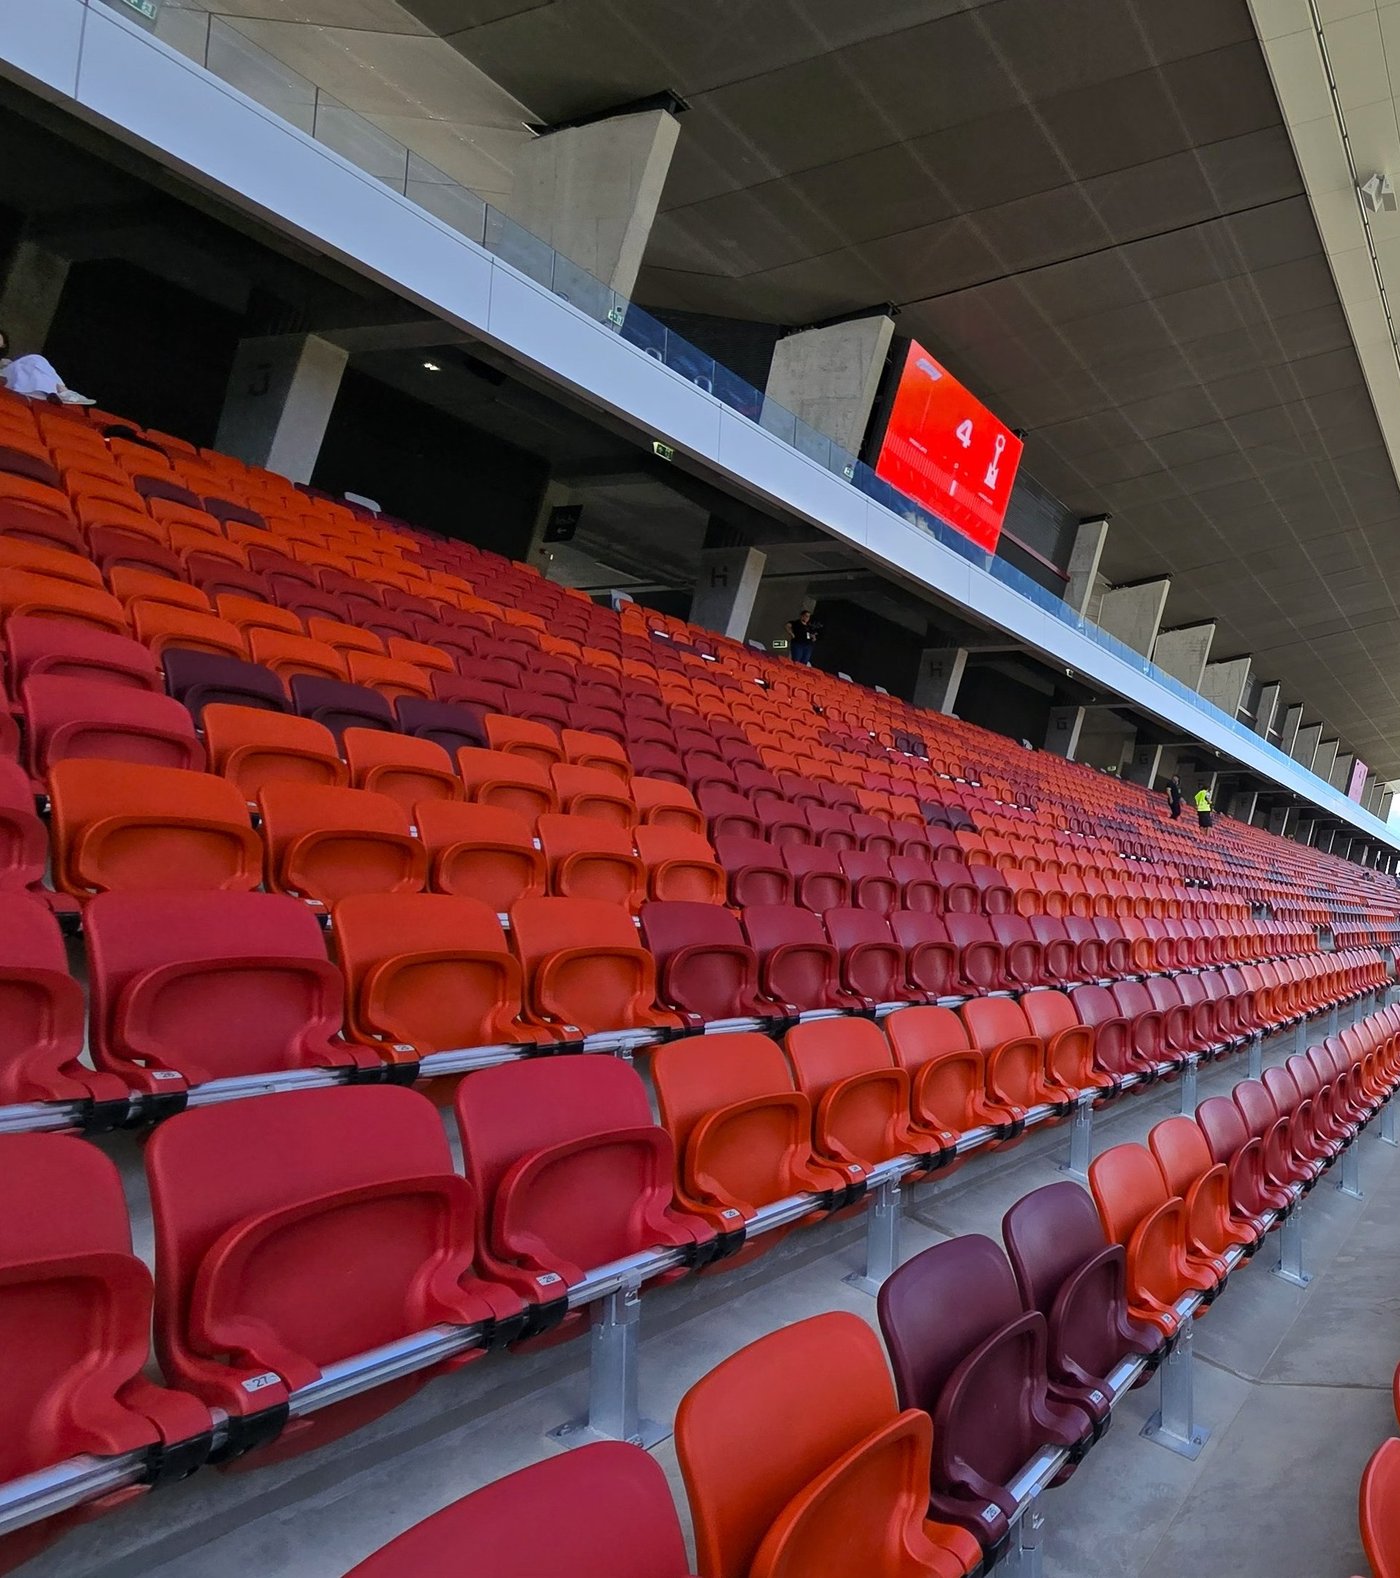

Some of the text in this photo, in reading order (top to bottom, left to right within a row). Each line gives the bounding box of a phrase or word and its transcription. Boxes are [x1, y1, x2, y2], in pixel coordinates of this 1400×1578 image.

[955, 418, 974, 449] 4
[710, 565, 728, 588] H
[252, 1376, 268, 1387] 27
